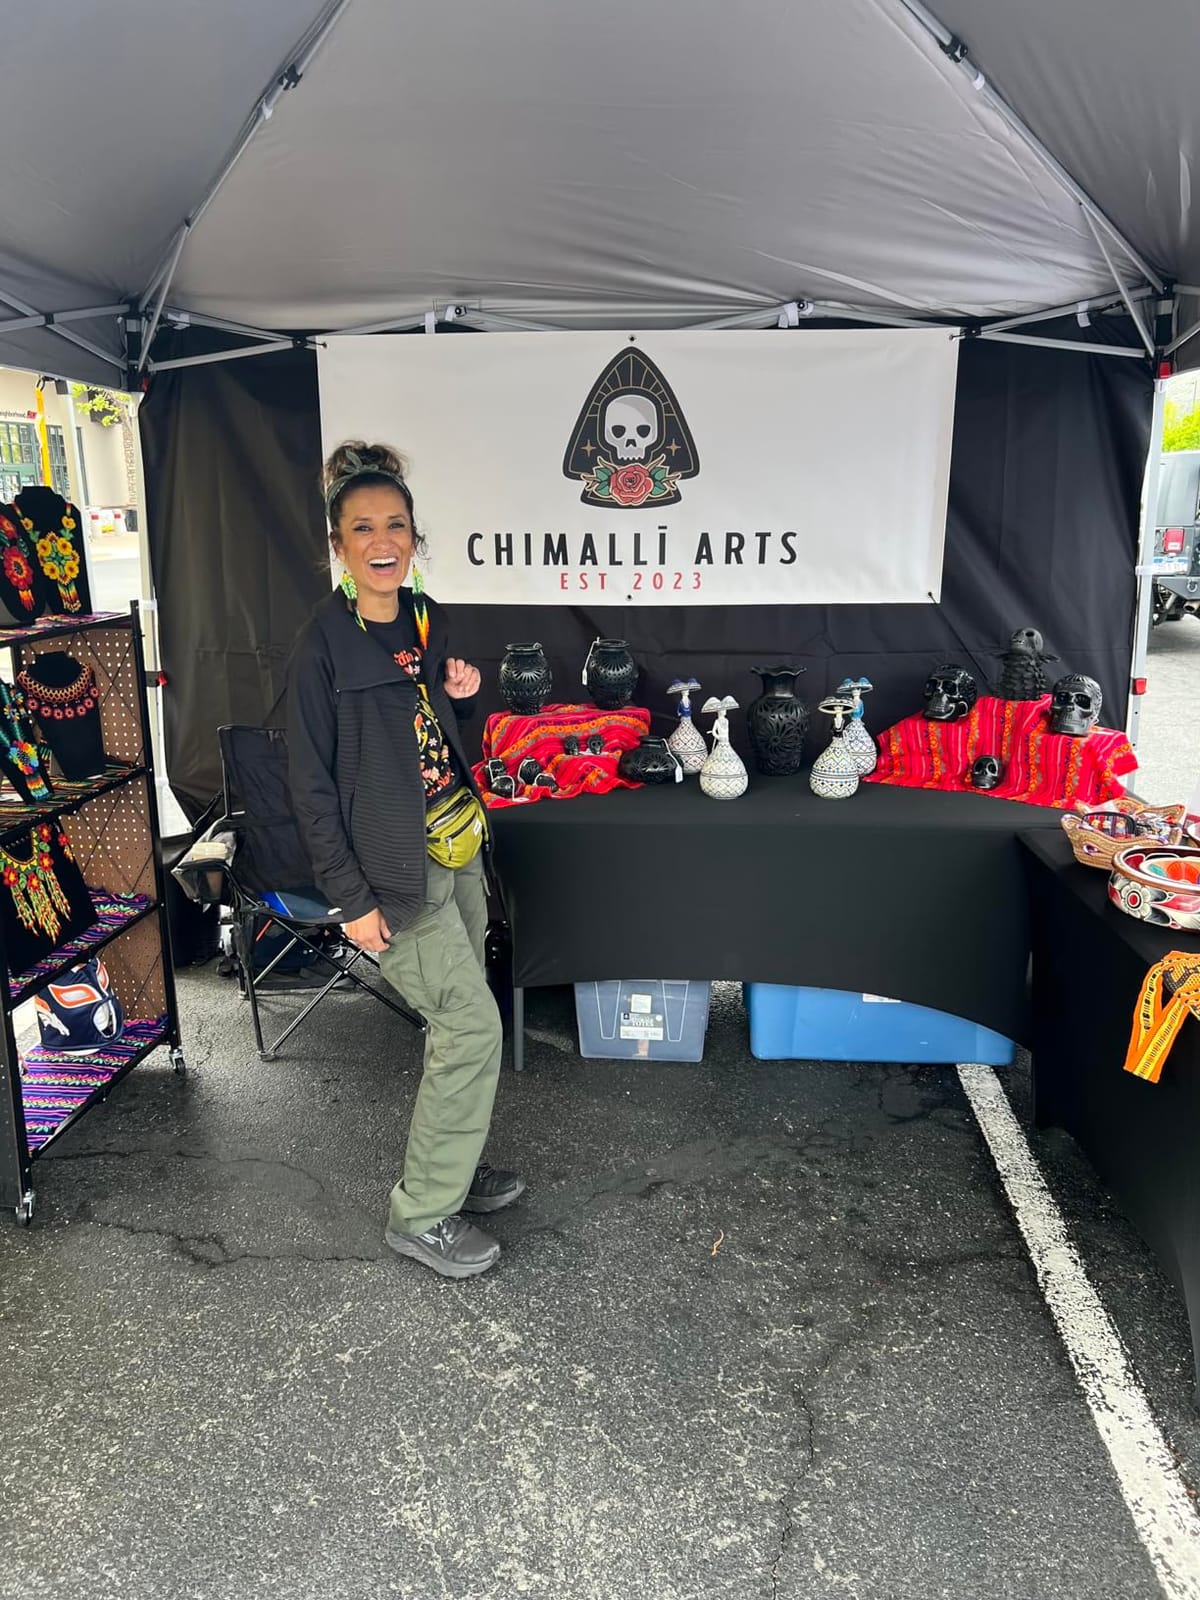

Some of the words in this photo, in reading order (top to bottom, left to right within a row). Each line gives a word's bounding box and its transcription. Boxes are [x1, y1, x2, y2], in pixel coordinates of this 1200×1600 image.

[467, 525, 668, 566] CHIMALLĪ
[694, 531, 798, 565] ARTS
[560, 572, 607, 590] EST
[632, 572, 702, 590] 2023
